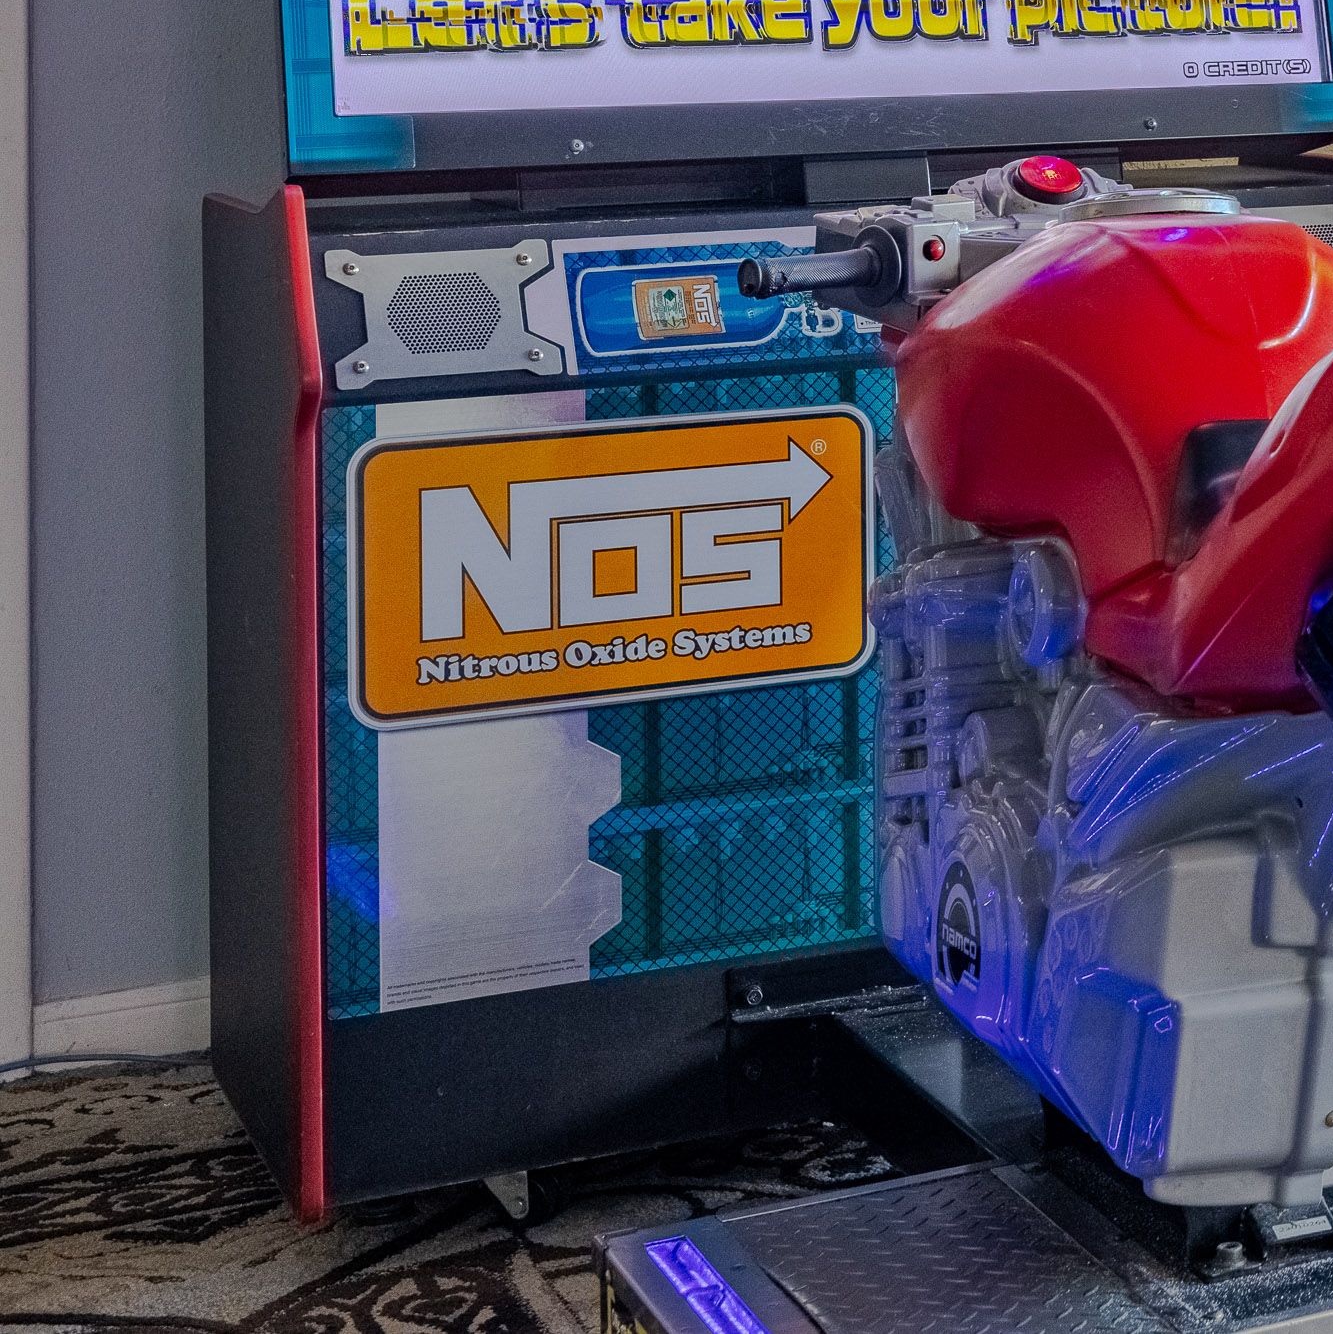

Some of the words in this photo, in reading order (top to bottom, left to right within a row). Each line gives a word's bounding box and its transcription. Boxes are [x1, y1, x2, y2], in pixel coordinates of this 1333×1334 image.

[1183, 61, 1199, 78] 0
[1203, 58, 1312, 77] CREDIT(S)
[692, 284, 718, 327] NOS
[419, 437, 833, 643] NOS
[417, 647, 558, 686] Nitrous
[564, 634, 667, 669] Oxide
[674, 622, 811, 661] Systems
[942, 922, 977, 960] namco
